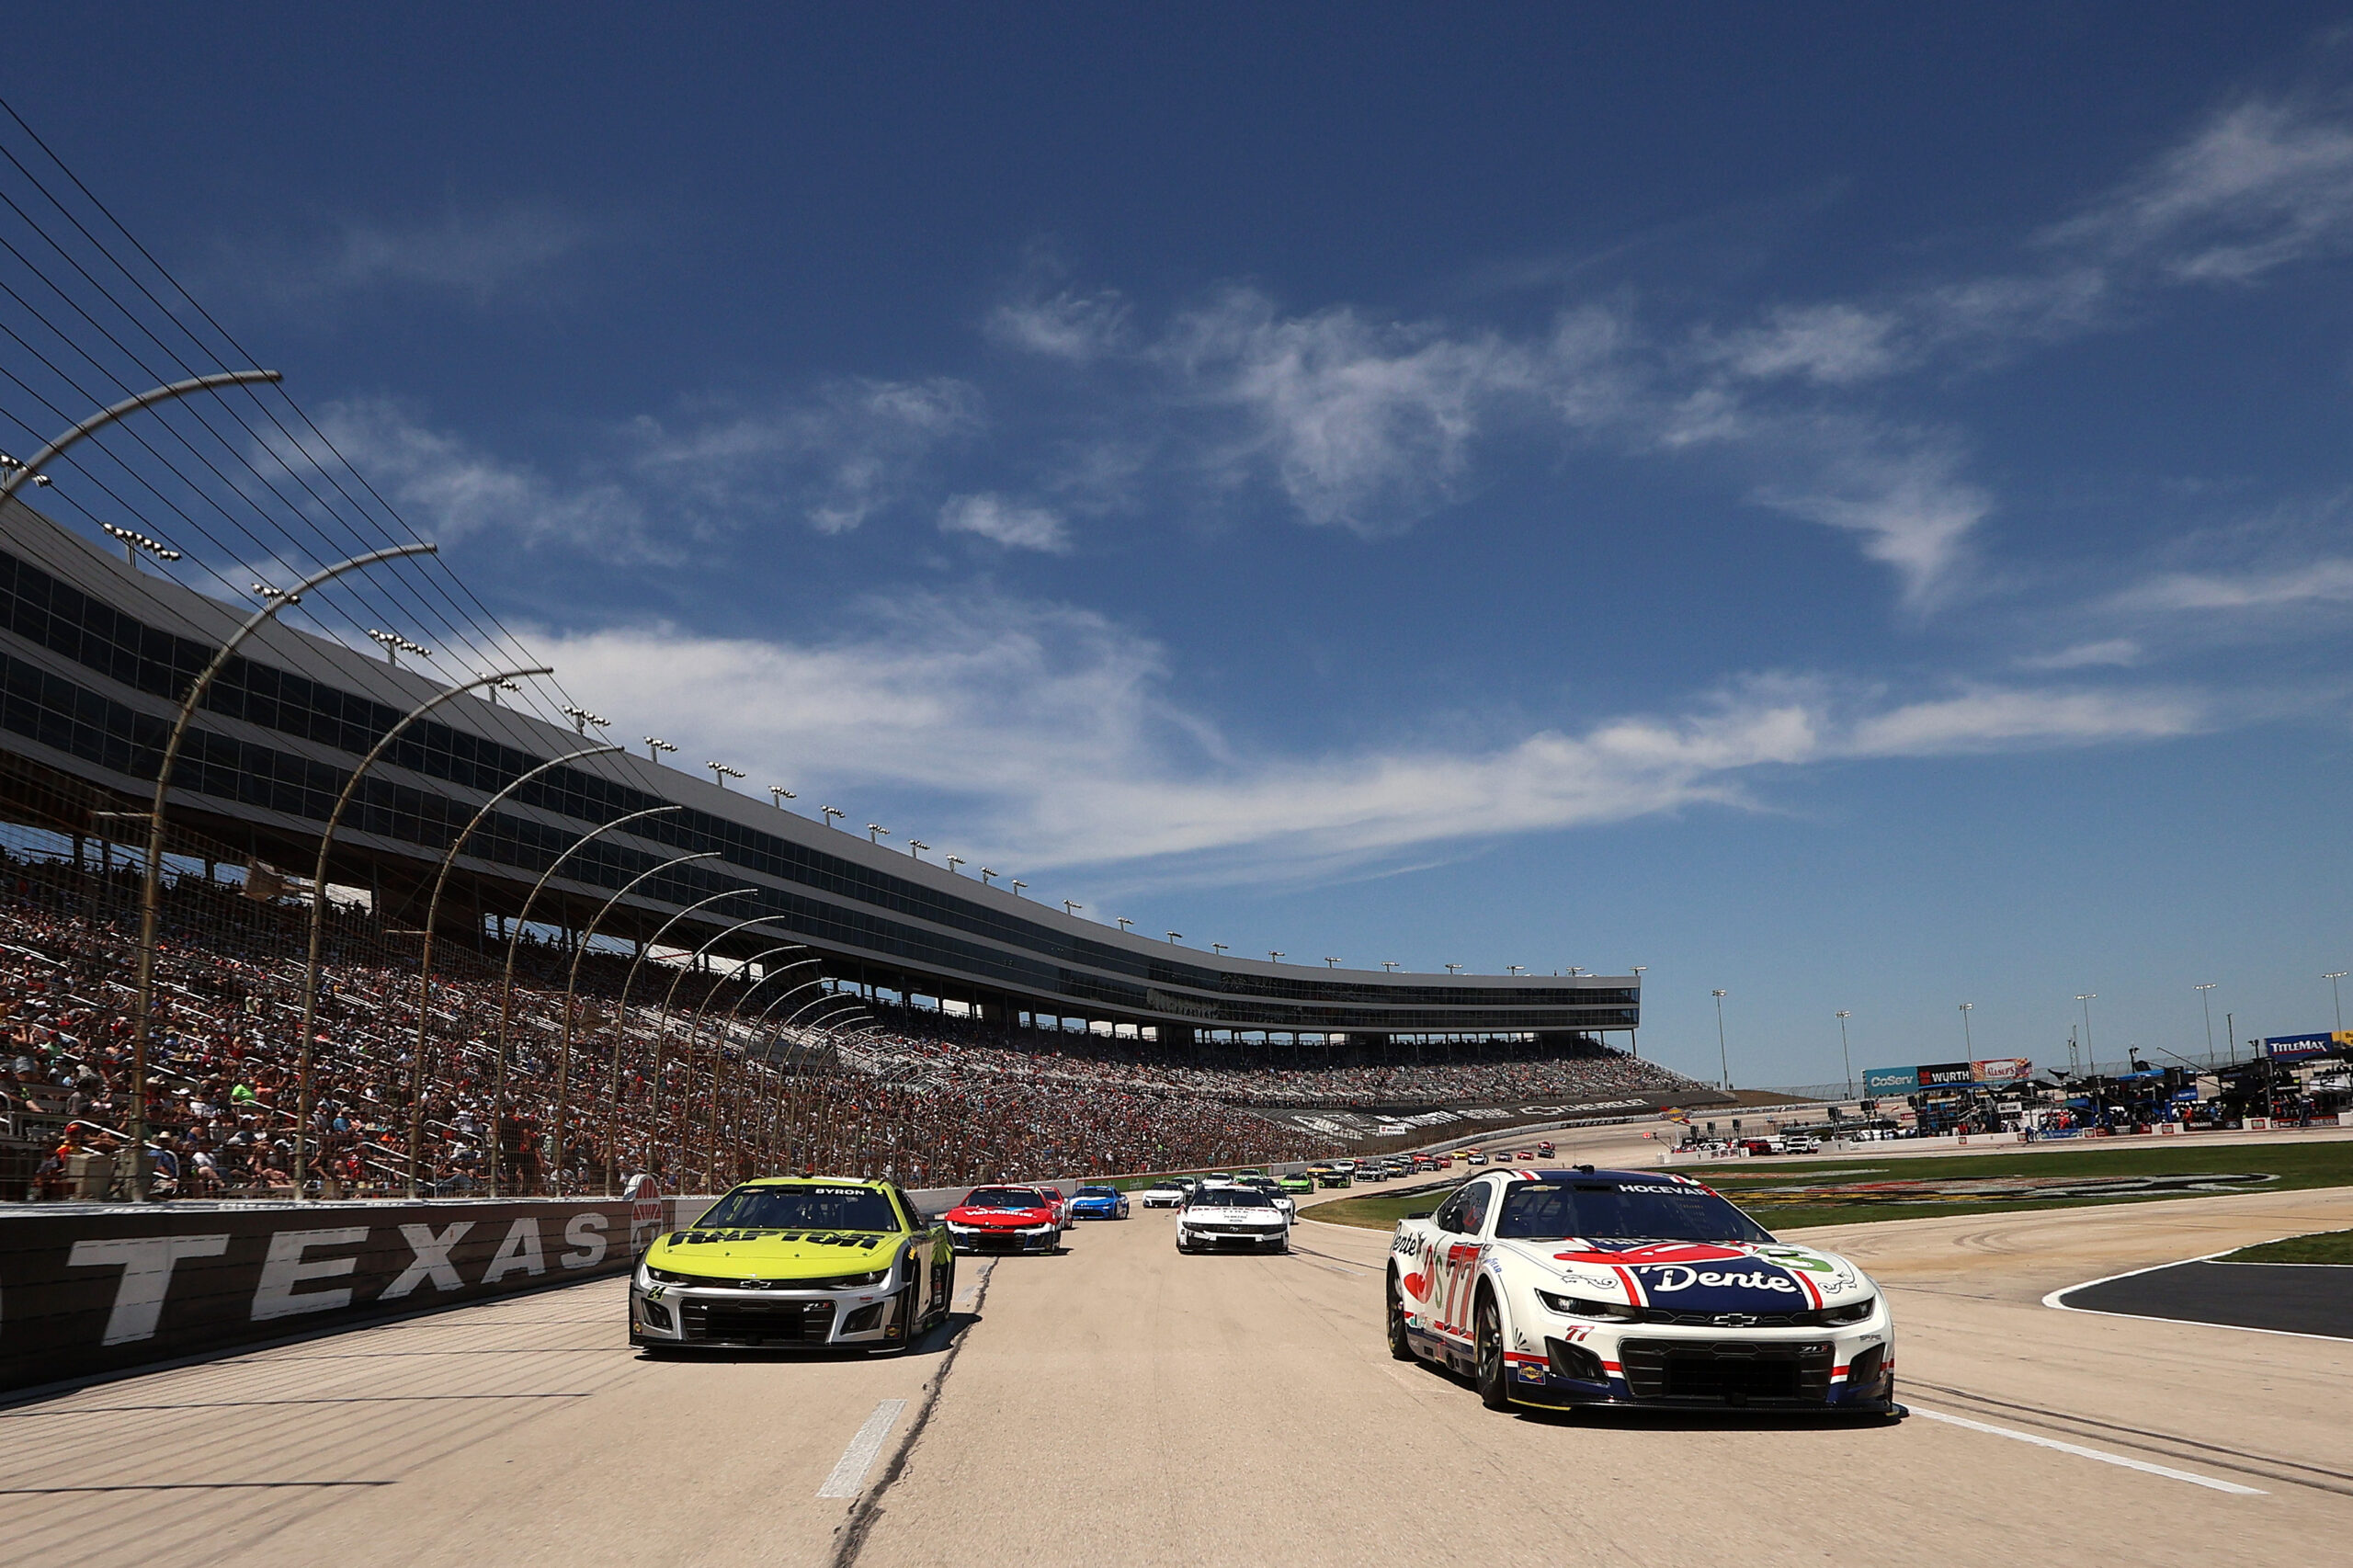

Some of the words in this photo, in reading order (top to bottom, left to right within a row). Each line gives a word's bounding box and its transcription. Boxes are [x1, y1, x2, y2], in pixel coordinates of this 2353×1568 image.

[1870, 1075, 1914, 1087] CoServ
[815, 1187, 865, 1196] BYRON
[1619, 1184, 1709, 1196] HOCEVAR
[66, 1212, 608, 1346] TEXAS
[647, 1286, 667, 1301] 24
[1565, 1325, 1596, 1341] 77
